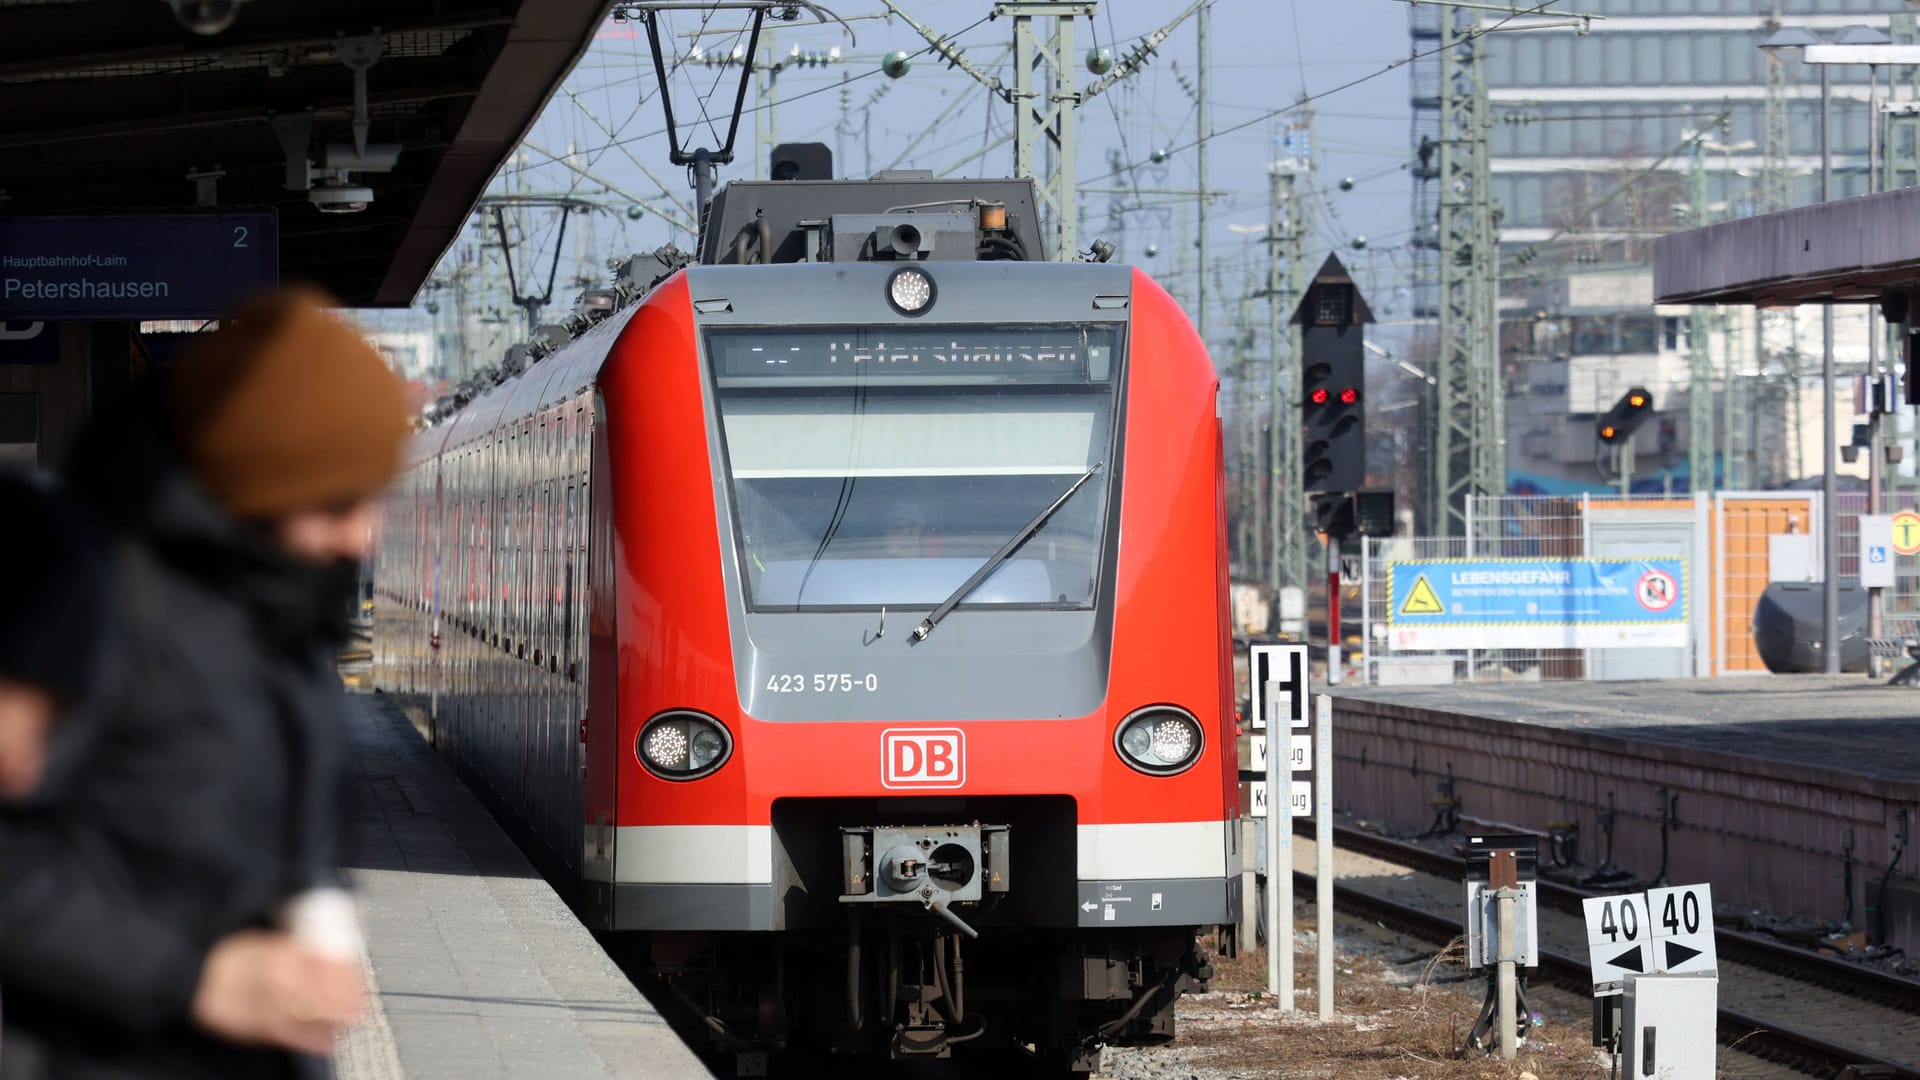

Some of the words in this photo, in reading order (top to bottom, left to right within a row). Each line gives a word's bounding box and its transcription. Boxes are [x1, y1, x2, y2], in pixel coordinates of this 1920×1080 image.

[233, 226, 248, 247] 2
[3, 255, 127, 270] Hauptbahnhof-Laim
[4, 278, 169, 299] Petershausen
[1451, 570, 1570, 585] LEBENSGEFAHR
[766, 674, 805, 692] 423
[813, 673, 878, 692] 575-0
[1258, 652, 1302, 720] H
[891, 738, 955, 779] DB
[1600, 898, 1638, 942] 40
[1662, 890, 1700, 936] 40
